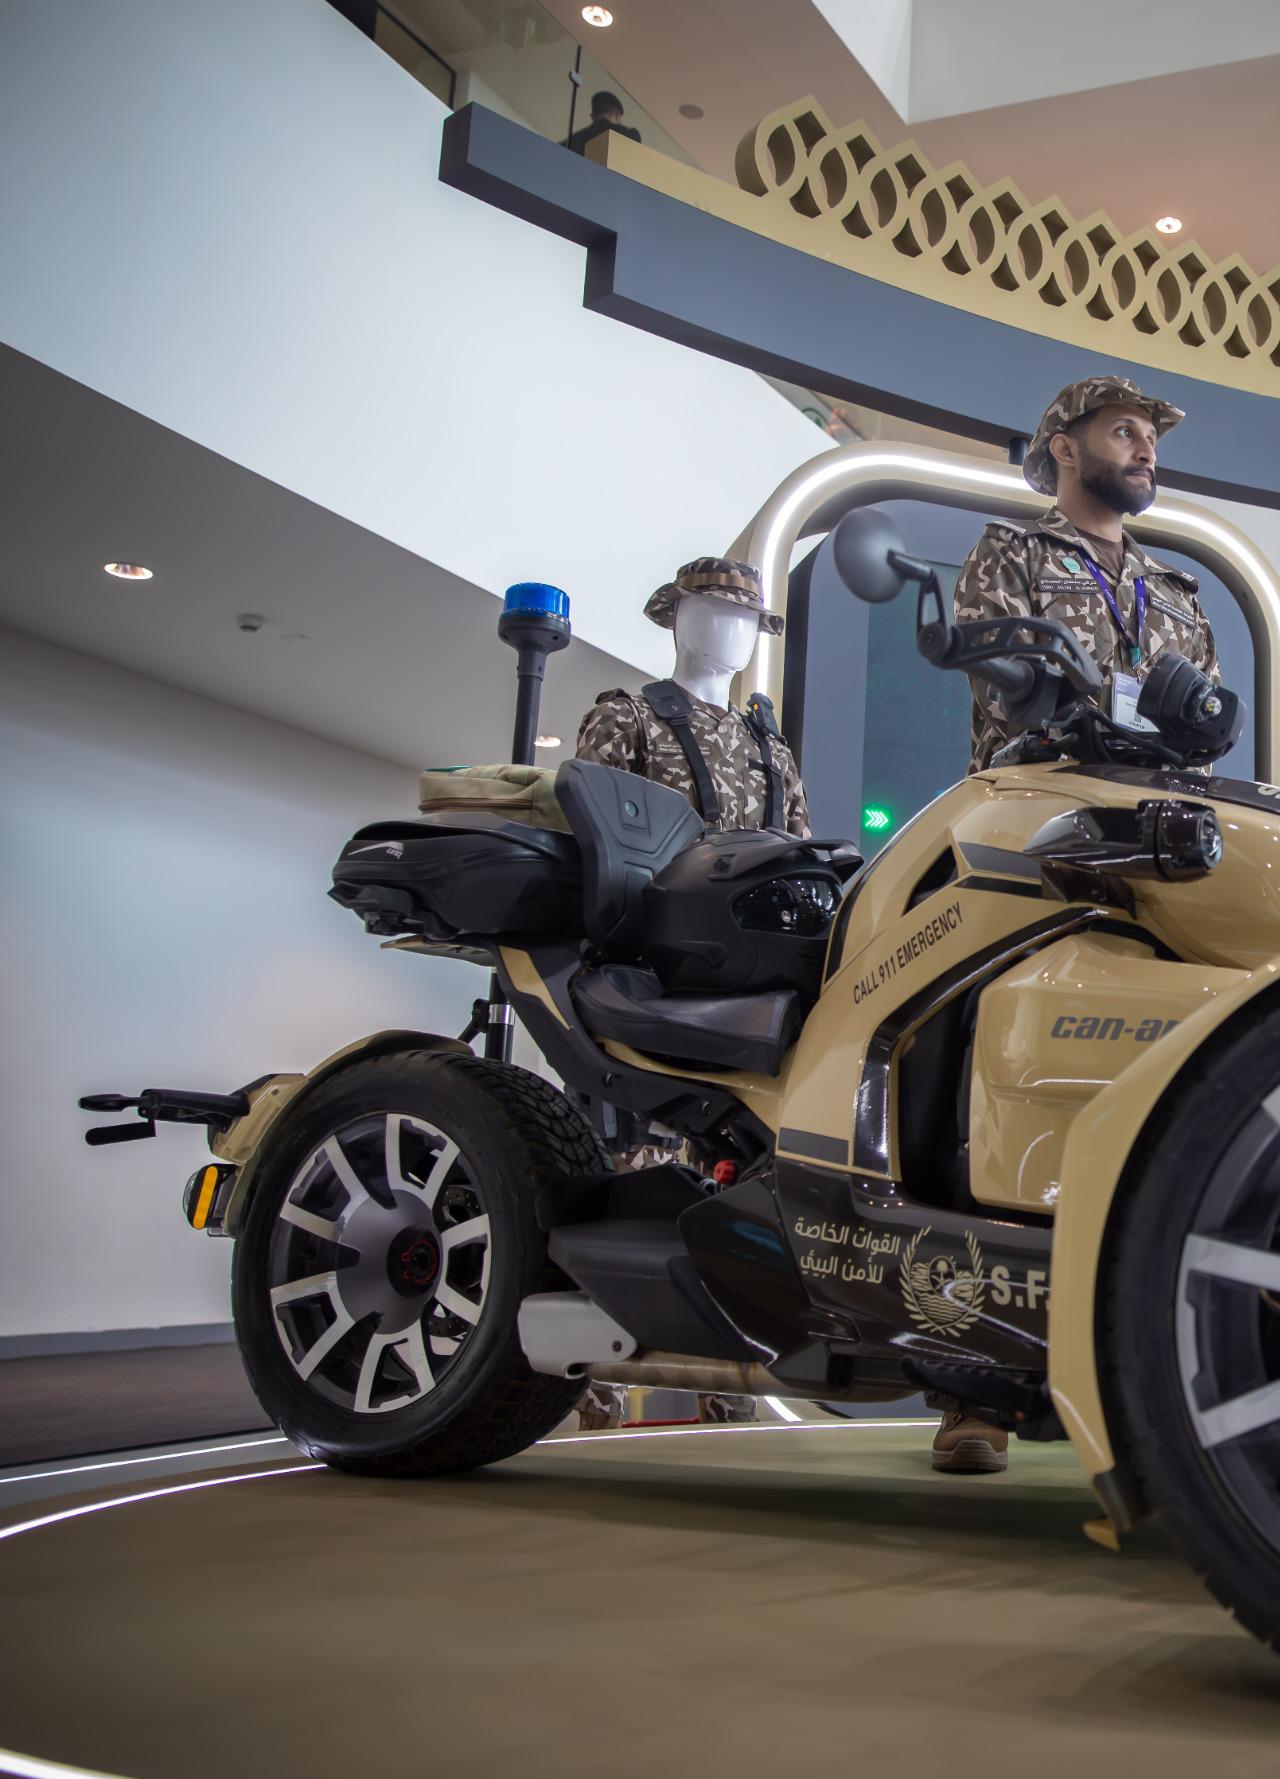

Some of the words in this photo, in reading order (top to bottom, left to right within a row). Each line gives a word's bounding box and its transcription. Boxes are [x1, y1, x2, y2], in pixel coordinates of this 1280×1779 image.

[853, 970, 879, 1005] CALL
[878, 955, 897, 984] 911
[896, 901, 963, 970] EMERGENCY
[794, 1216, 850, 1246] الخاصة
[852, 1226, 901, 1256] القوات
[800, 1249, 839, 1280] البيئي
[841, 1256, 884, 1284] للأمن
